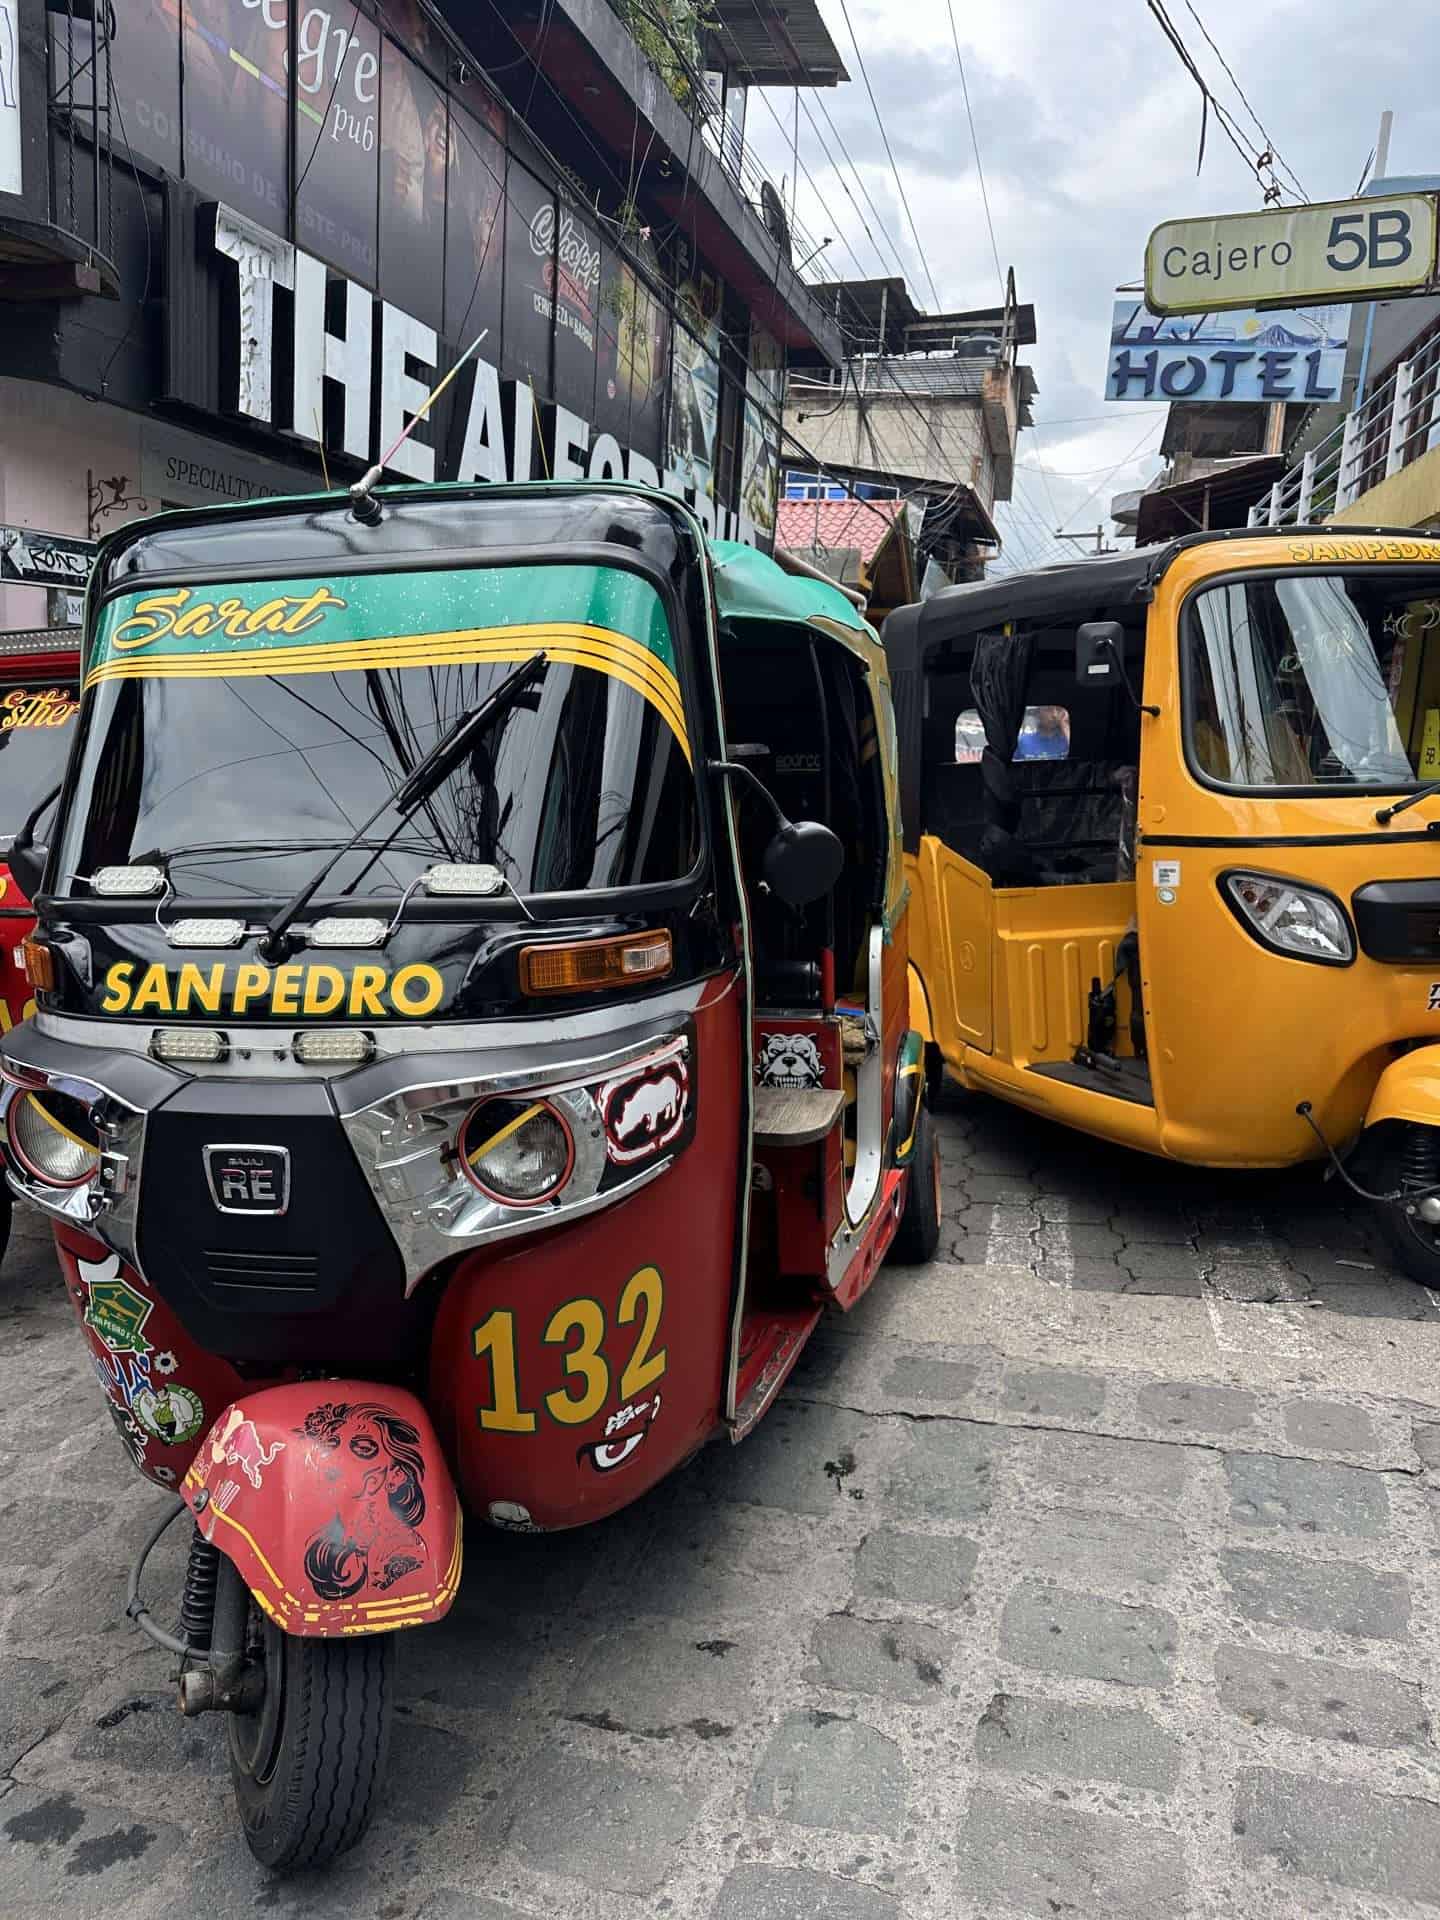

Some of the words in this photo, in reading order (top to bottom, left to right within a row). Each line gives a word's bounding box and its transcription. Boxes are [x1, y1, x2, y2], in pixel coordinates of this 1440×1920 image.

[331, 103, 374, 152] pub
[1162, 240, 1293, 281] Cajero
[1326, 210, 1412, 272] 5B
[215, 200, 439, 483] THE
[1112, 349, 1337, 398] HOTEL
[166, 456, 256, 499] SPECIALTY
[111, 587, 347, 650] Sarat
[102, 960, 226, 1014] SAN
[232, 962, 444, 1017] PEDRO
[221, 1168, 276, 1200] RE
[473, 1264, 668, 1433] 132
